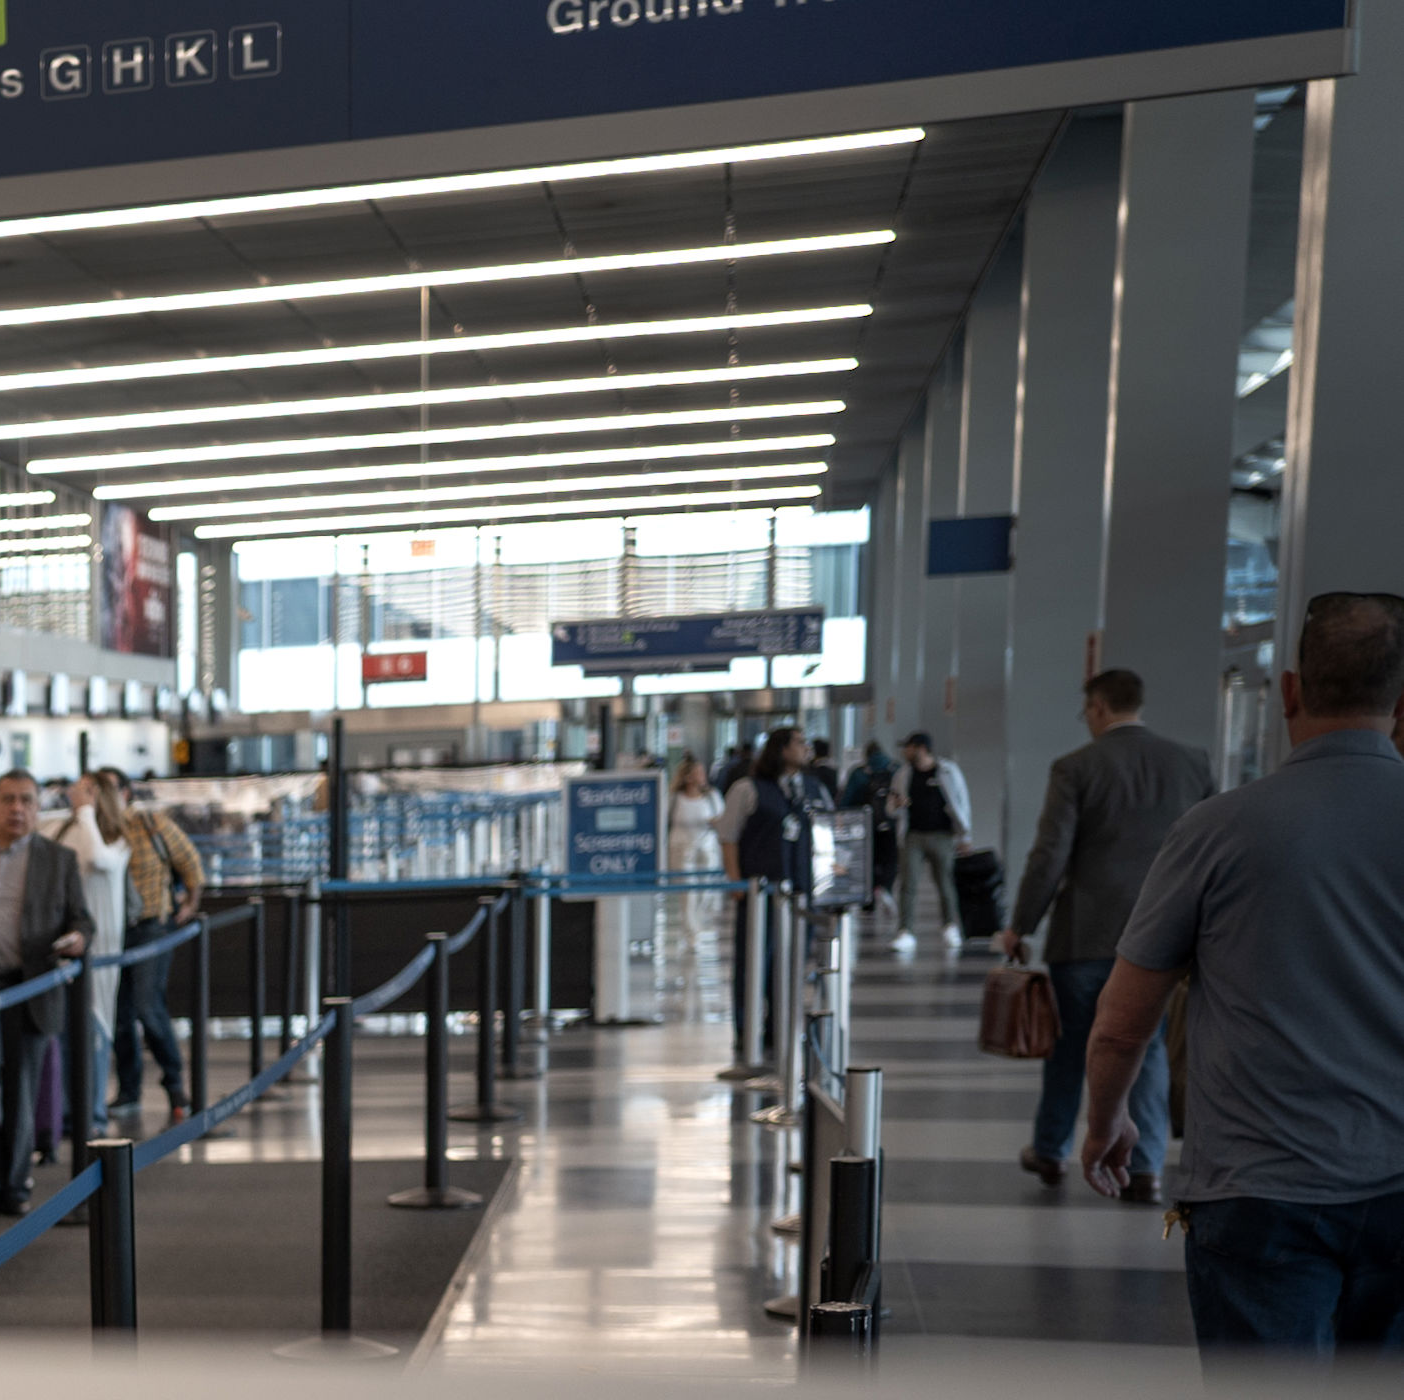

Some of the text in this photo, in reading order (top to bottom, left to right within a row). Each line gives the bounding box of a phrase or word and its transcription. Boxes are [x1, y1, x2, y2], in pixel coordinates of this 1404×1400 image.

[49, 54, 82, 92] G
[112, 45, 145, 85] H
[175, 39, 209, 79] K
[241, 33, 270, 71] L
[576, 783, 651, 808] Standard
[574, 831, 654, 855] Screening
[590, 853, 640, 876] ONLY
